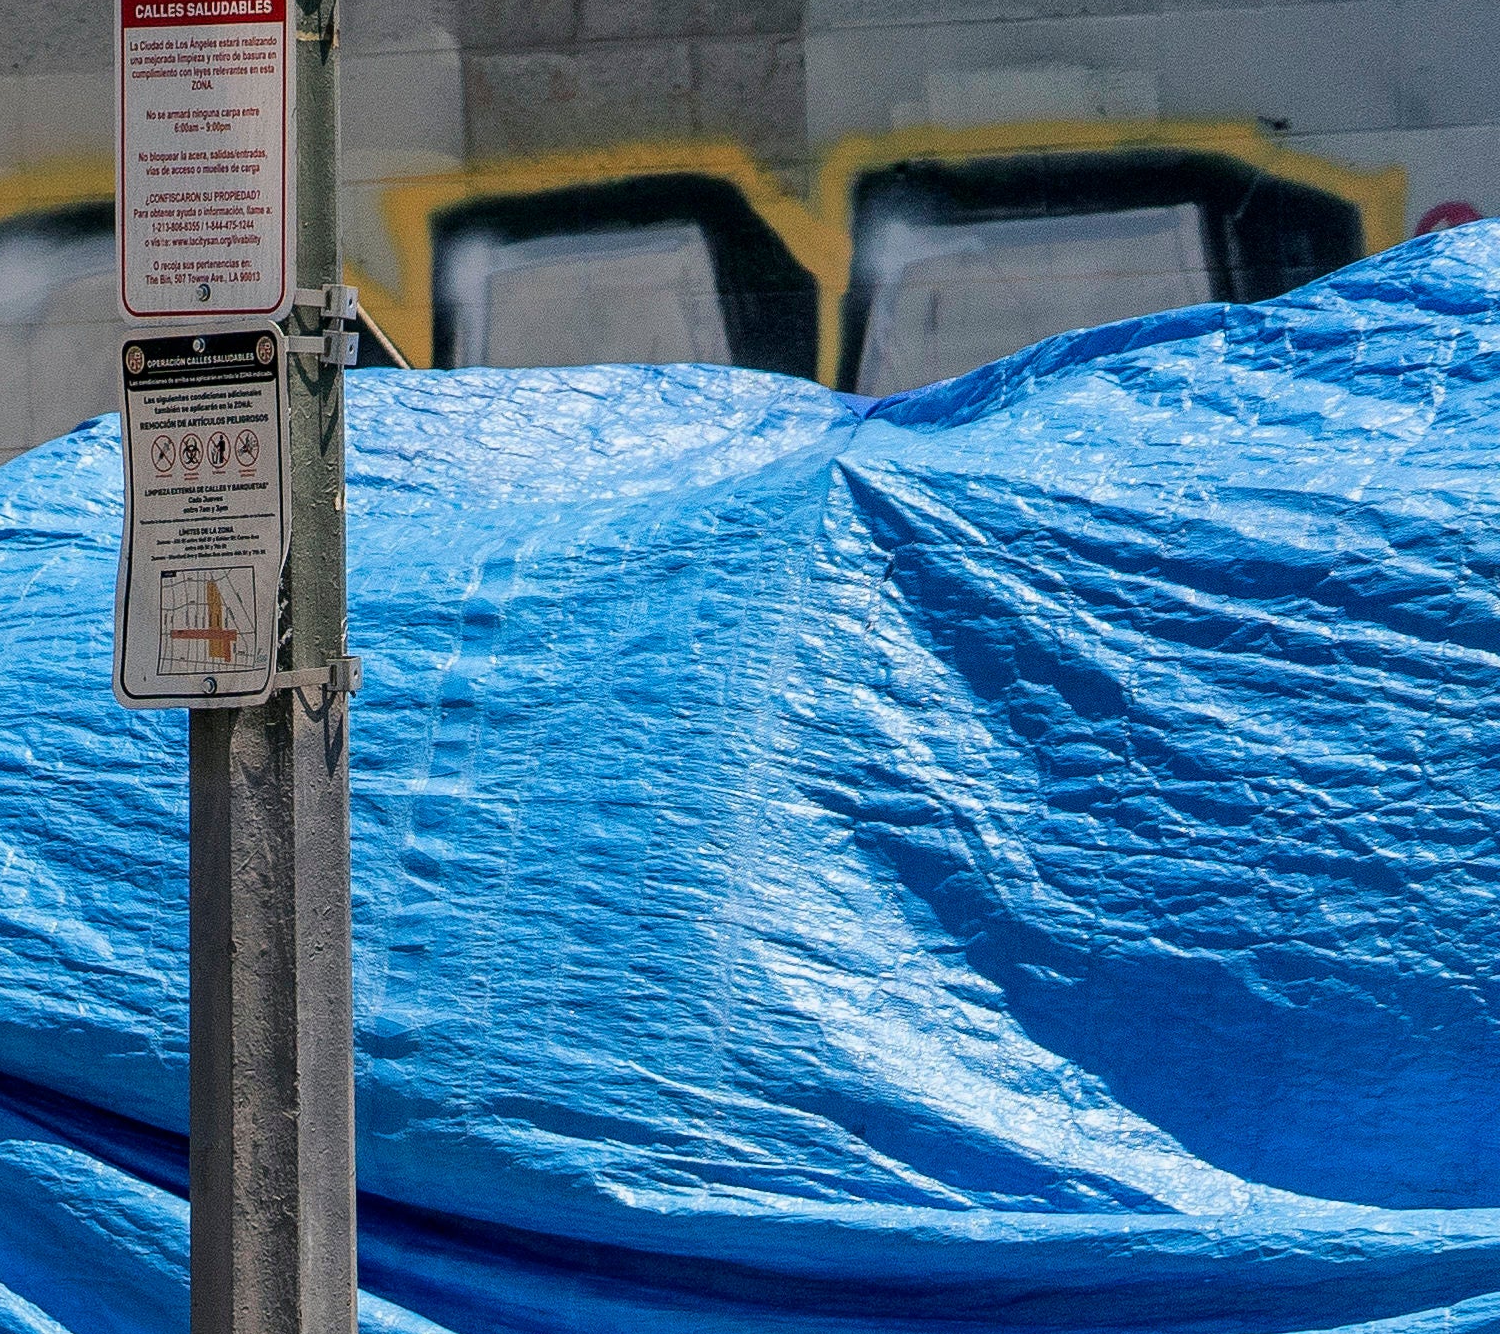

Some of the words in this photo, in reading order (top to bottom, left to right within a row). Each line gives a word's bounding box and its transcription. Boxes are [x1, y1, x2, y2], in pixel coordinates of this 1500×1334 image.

[135, 3, 184, 19] CALLES
[186, 0, 272, 17] SALUDABLES
[130, 41, 138, 51] La
[140, 41, 164, 51] Ciudad
[166, 40, 174, 49] de
[176, 39, 188, 49] Los
[190, 37, 216, 51] Ángeles
[219, 37, 240, 48] estará
[242, 35, 278, 47] realizando
[130, 57, 142, 65] una
[144, 55, 176, 66] mejorada
[178, 54, 204, 65] limpieza
[206, 55, 211, 64] y
[213, 52, 230, 61] retiro
[232, 51, 240, 61] de
[242, 51, 266, 61] basura
[268, 51, 276, 59] en
[132, 68, 178, 80] cumplimiento
[180, 69, 192, 77] con
[194, 67, 211, 79] leyes
[212, 65, 248, 75] relevantes
[250, 66, 258, 74] en
[260, 65, 274, 73] esta
[146, 110, 156, 119] No
[158, 111, 166, 119] se
[192, 109, 220, 120] ninguna
[222, 109, 240, 119] carpa
[242, 107, 260, 116] entre
[138, 152, 148, 162] No
[150, 152, 179, 163] bloquear
[181, 151, 186, 161] la
[188, 151, 208, 161] acera,
[162, 165, 170, 175] de
[172, 167, 194, 175] acceso
[202, 164, 228, 174] muelles
[230, 163, 240, 173] de
[241, 164, 260, 175] carga
[146, 193, 200, 205] ¿CONFISCARON
[202, 191, 212, 201] SU
[214, 190, 260, 201] PROPIEDAD?
[134, 209, 148, 218] Para
[150, 207, 174, 217] obtener
[176, 207, 196, 219] ayuda
[204, 205, 244, 217] información,
[246, 205, 264, 215] llame
[145, 239, 150, 247] o
[154, 261, 159, 271] O
[161, 261, 182, 271] recoja
[183, 260, 194, 268] sus
[196, 259, 240, 271] pertenencias
[241, 259, 252, 267] en:
[146, 275, 158, 285] The
[160, 274, 172, 285] Bin,
[174, 273, 186, 283] 507
[188, 273, 209, 283] Towne
[228, 272, 238, 283] LA
[147, 355, 186, 367] OPERACIÓN
[187, 356, 212, 365] CALLES
[212, 353, 254, 363] SALUDABLES
[144, 396, 155, 405] Las
[140, 419, 176, 430] REMOCIÓN
[177, 419, 186, 427] DE
[188, 415, 225, 427] ARTÍCULOS
[226, 413, 268, 425] PELIGROSOS
[145, 487, 170, 497] LIMPIEZA
[171, 486, 196, 495] EXTENSA
[197, 485, 204, 493] DE
[205, 485, 226, 493] CALLES
